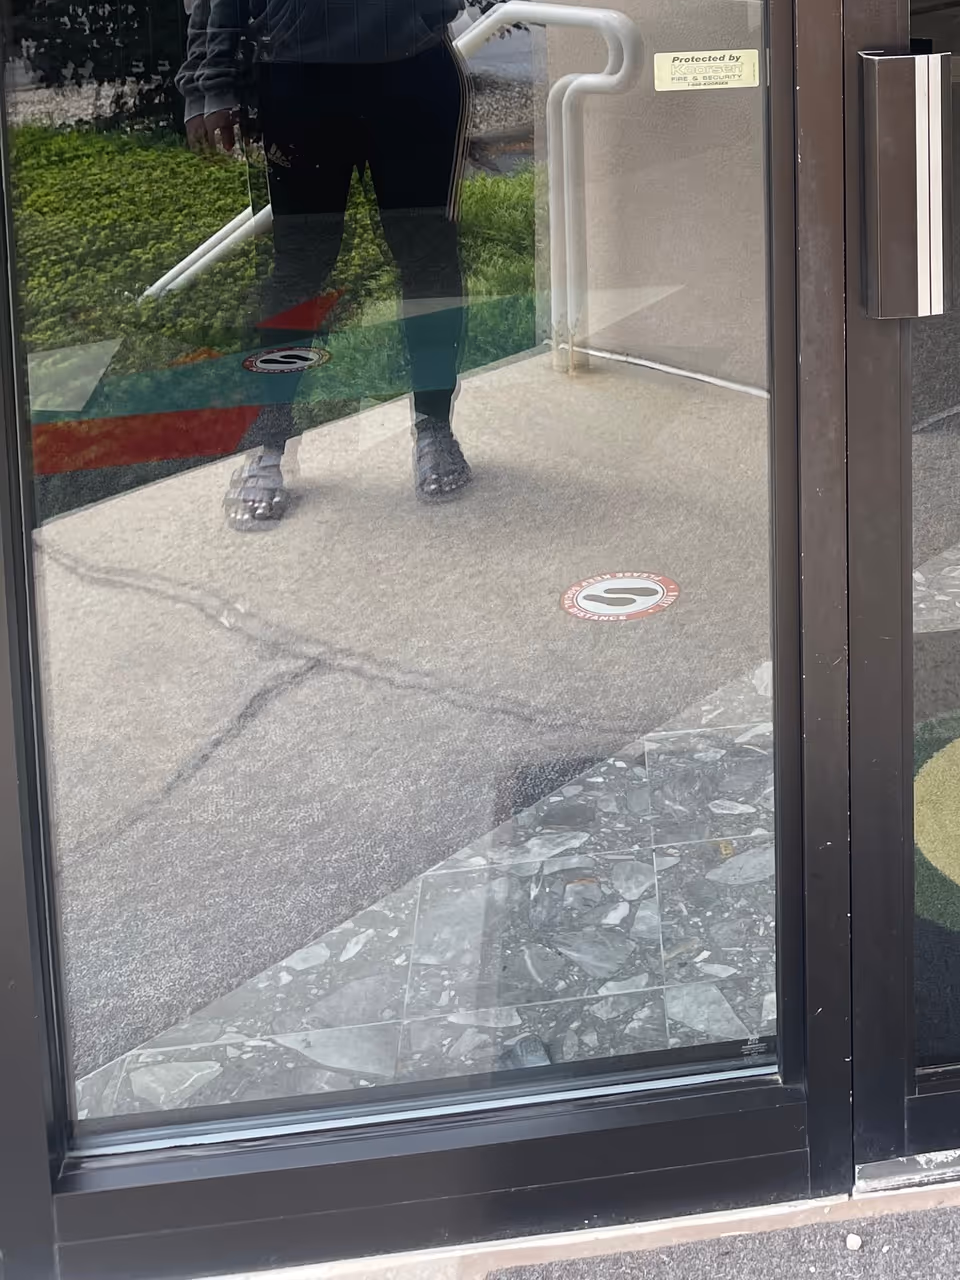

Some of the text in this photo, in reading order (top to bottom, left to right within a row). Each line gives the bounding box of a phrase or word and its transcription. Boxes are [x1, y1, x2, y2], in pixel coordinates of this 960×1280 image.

[671, 54, 742, 64] Protected by
[702, 73, 742, 81] SECURITY
